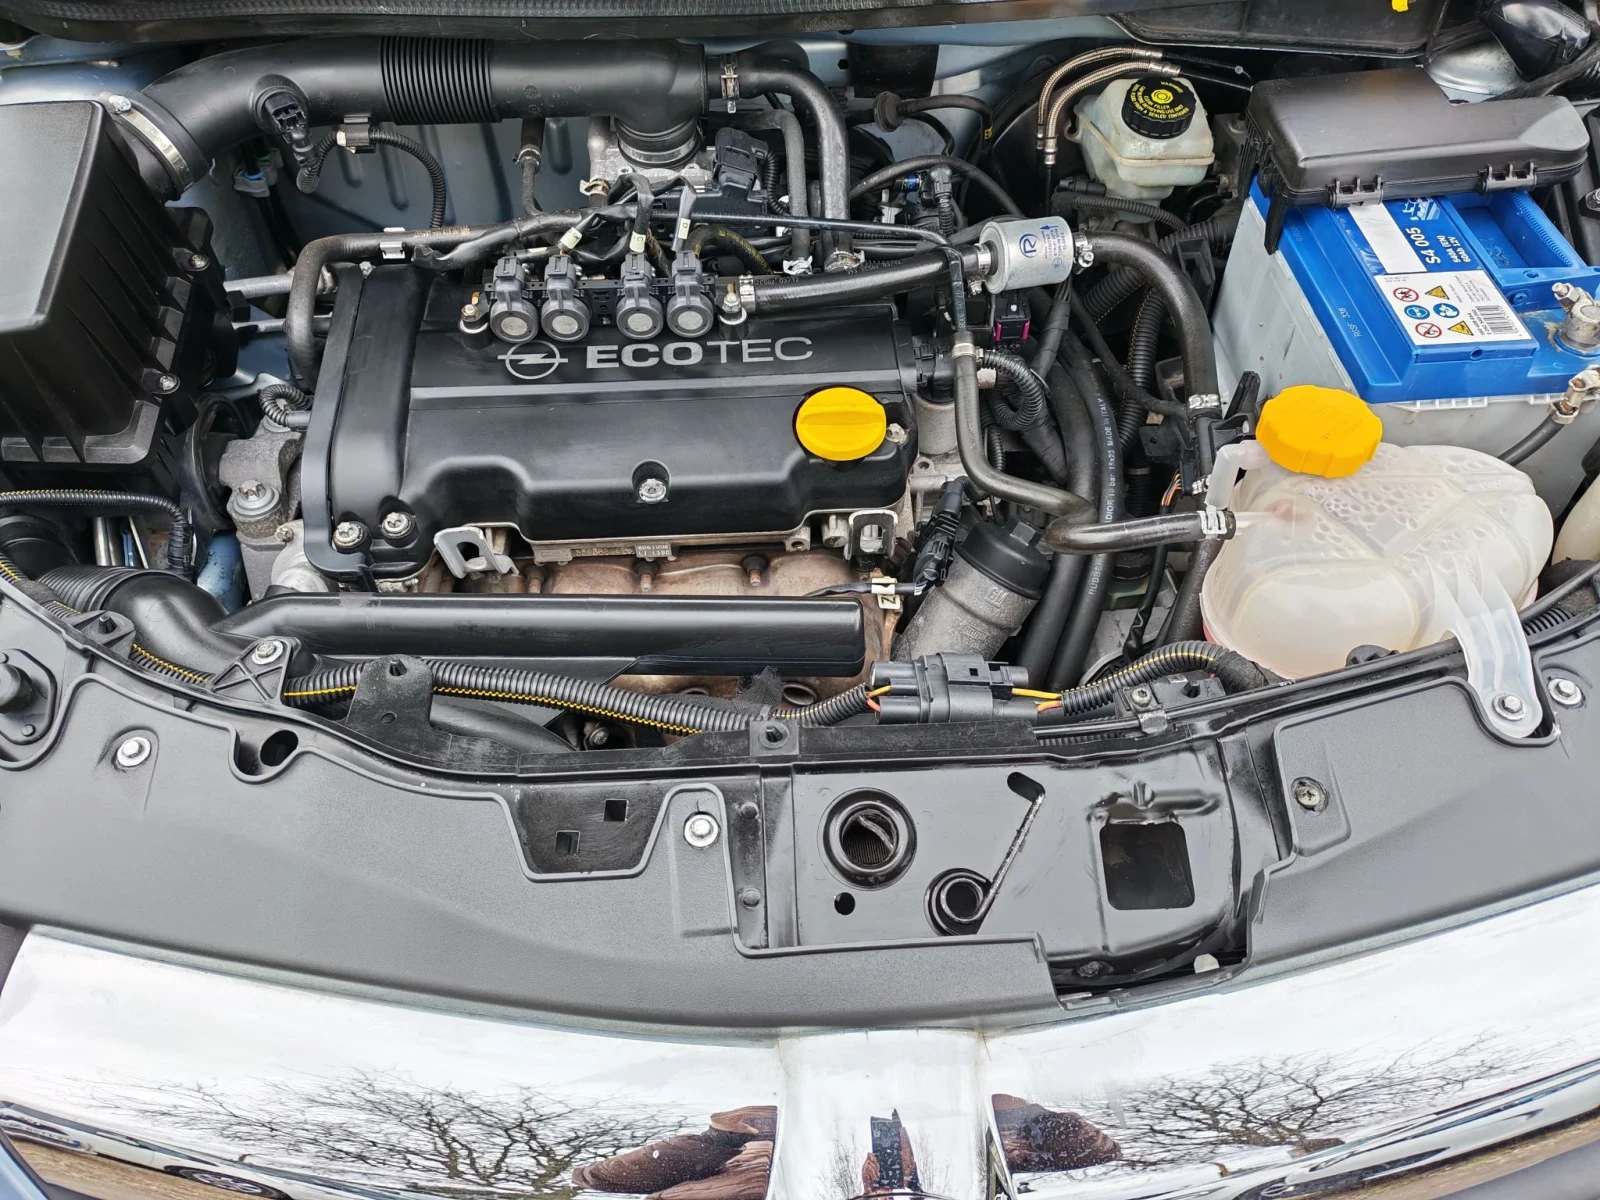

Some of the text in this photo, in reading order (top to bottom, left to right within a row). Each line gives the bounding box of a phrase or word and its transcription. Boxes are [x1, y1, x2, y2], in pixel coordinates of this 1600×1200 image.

[1405, 227, 1441, 264] S4 005
[1436, 235, 1451, 247] (EN)
[1447, 236, 1461, 246] 12V
[586, 336, 814, 370] ECOTEC
[1098, 398, 1109, 416] ITALY
[1105, 426, 1113, 446] MADE
